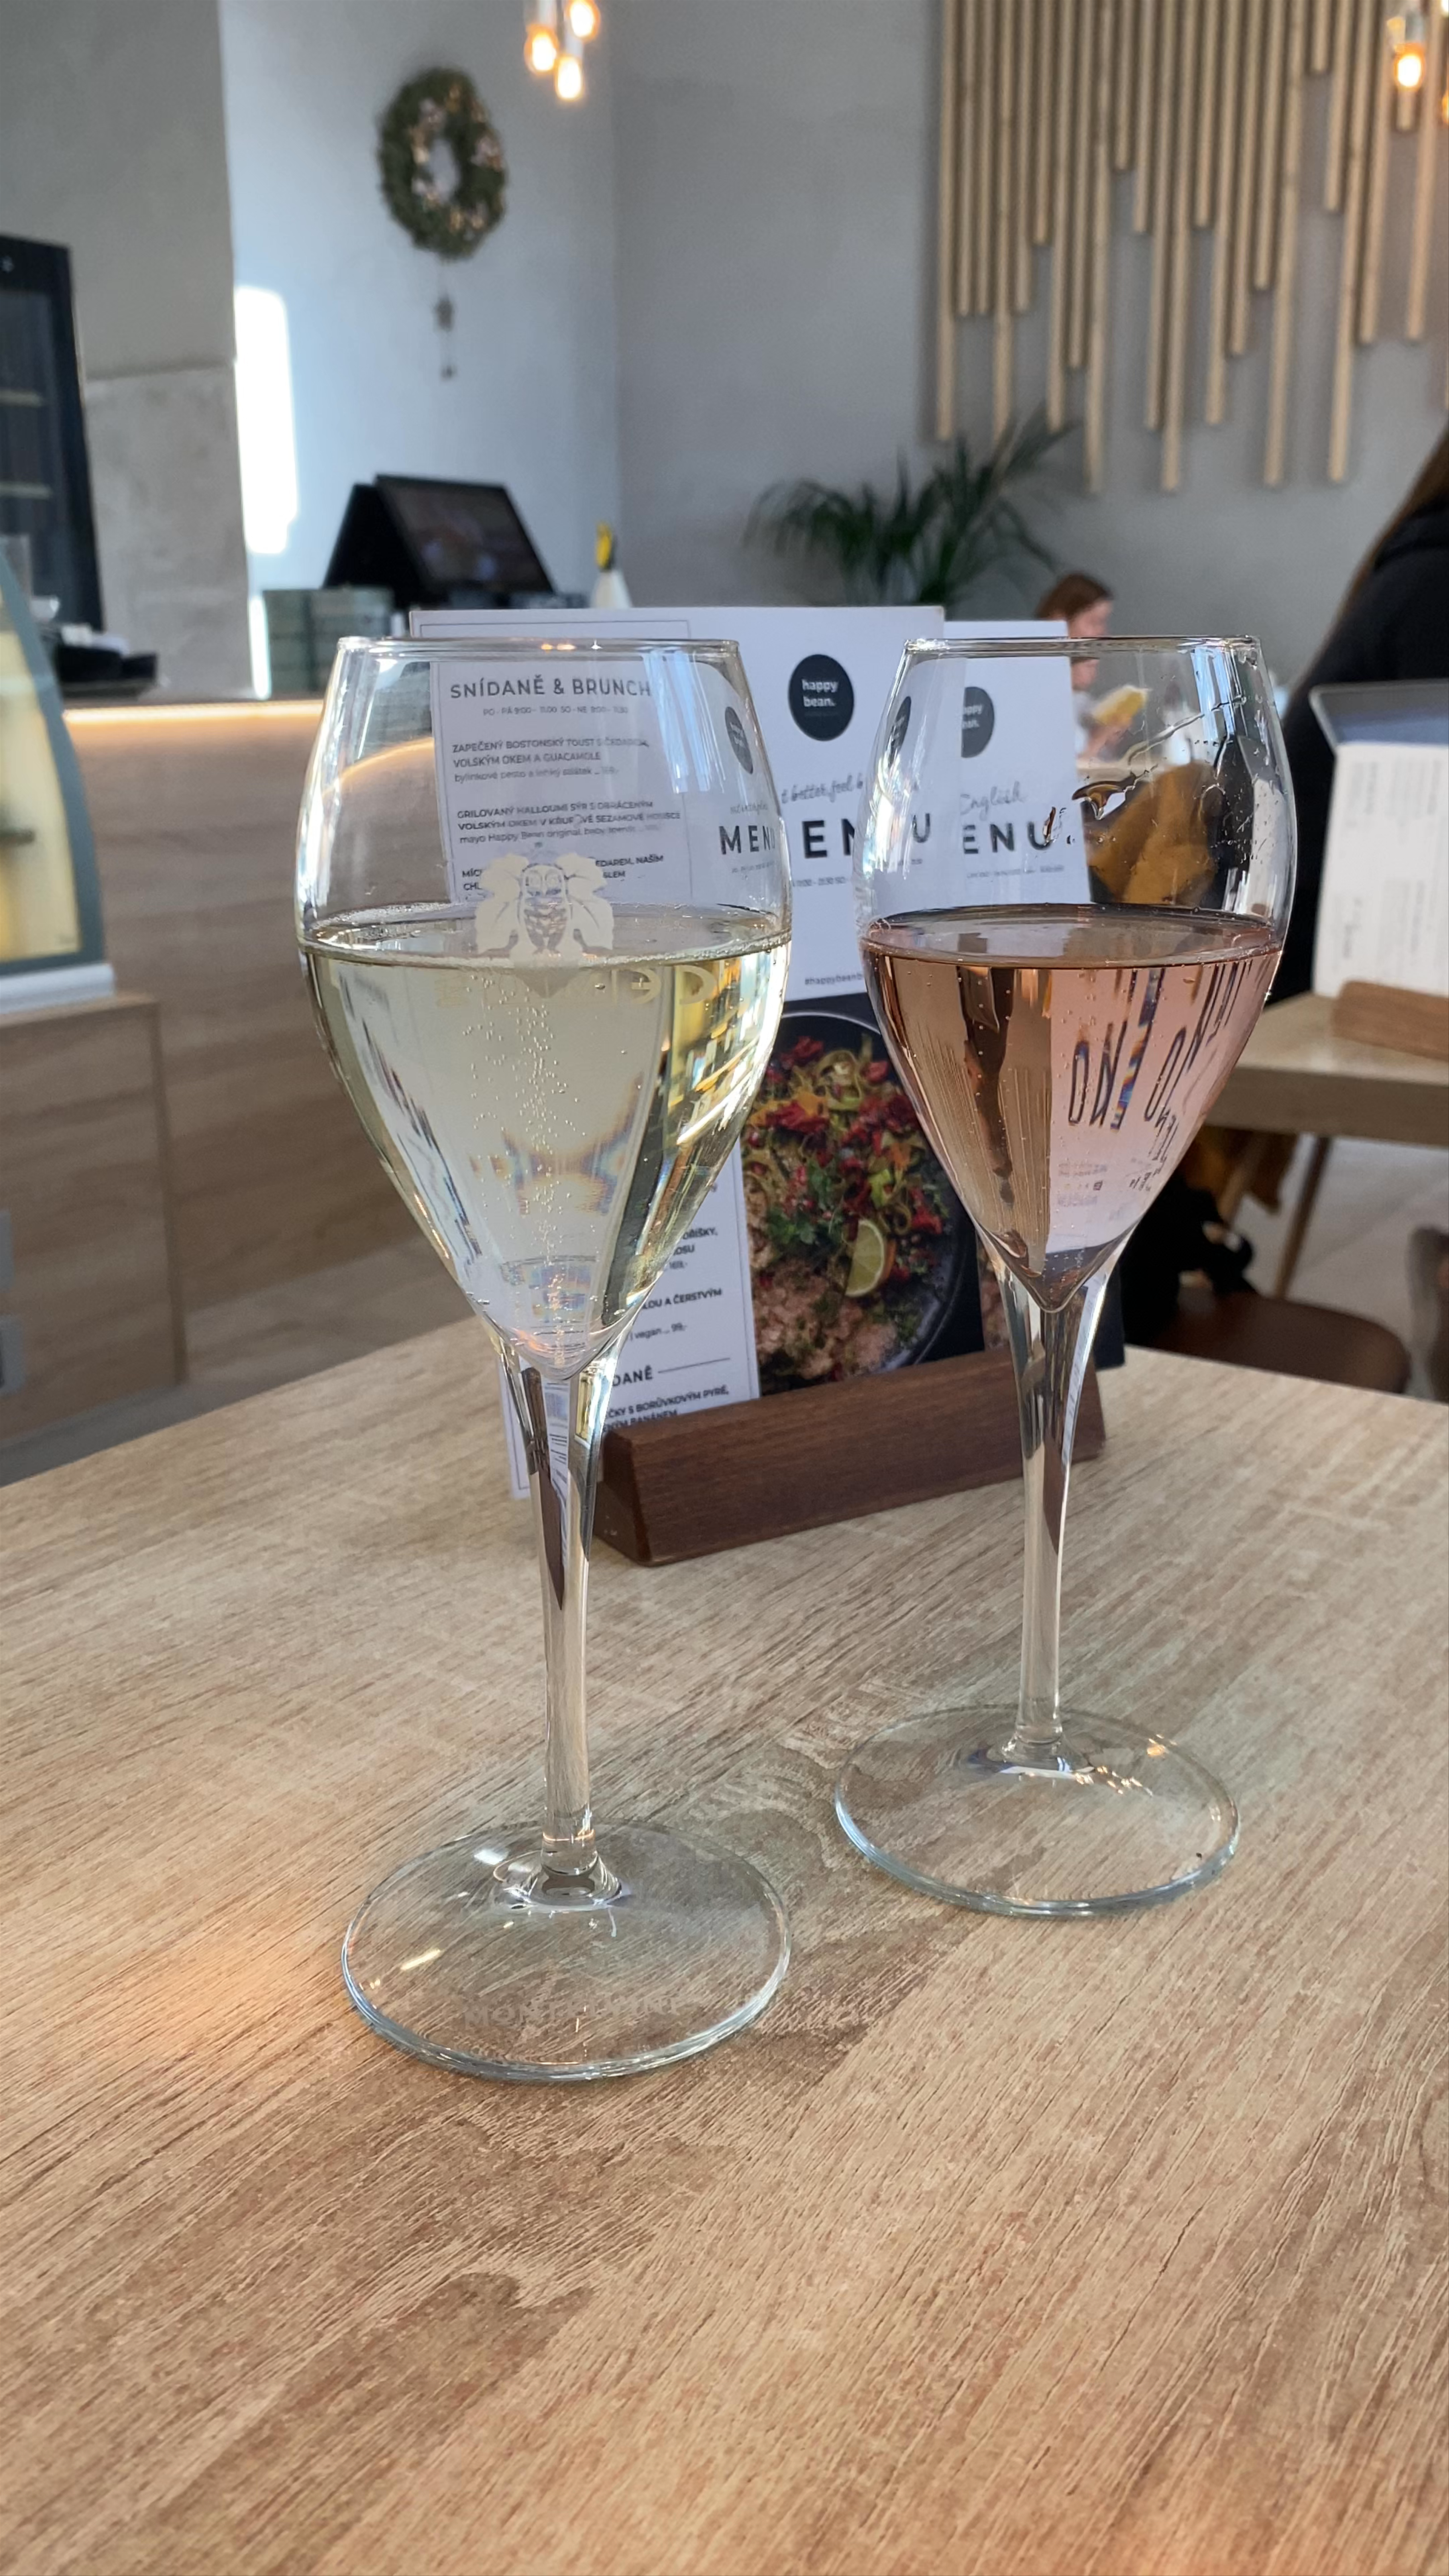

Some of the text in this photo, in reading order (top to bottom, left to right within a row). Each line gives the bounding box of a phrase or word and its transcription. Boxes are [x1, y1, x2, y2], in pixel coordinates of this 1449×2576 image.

[451, 674, 651, 698] SNÍDANĚ & BRUNCH
[801, 679, 838, 693] happy
[803, 696, 837, 707] bean.
[452, 740, 503, 753] ZAPEČENÝ
[506, 737, 564, 749] BOSTONSKÝ
[454, 755, 500, 768] VOLSKÝM
[502, 755, 531, 764] OKEM
[543, 752, 601, 762] GUACAMOLE
[457, 805, 514, 818] GRILOVANÝ
[458, 820, 505, 830] VOLSKÝM
[665, 1296, 672, 1305] A
[673, 1287, 722, 1305] ČERSTVÝM
